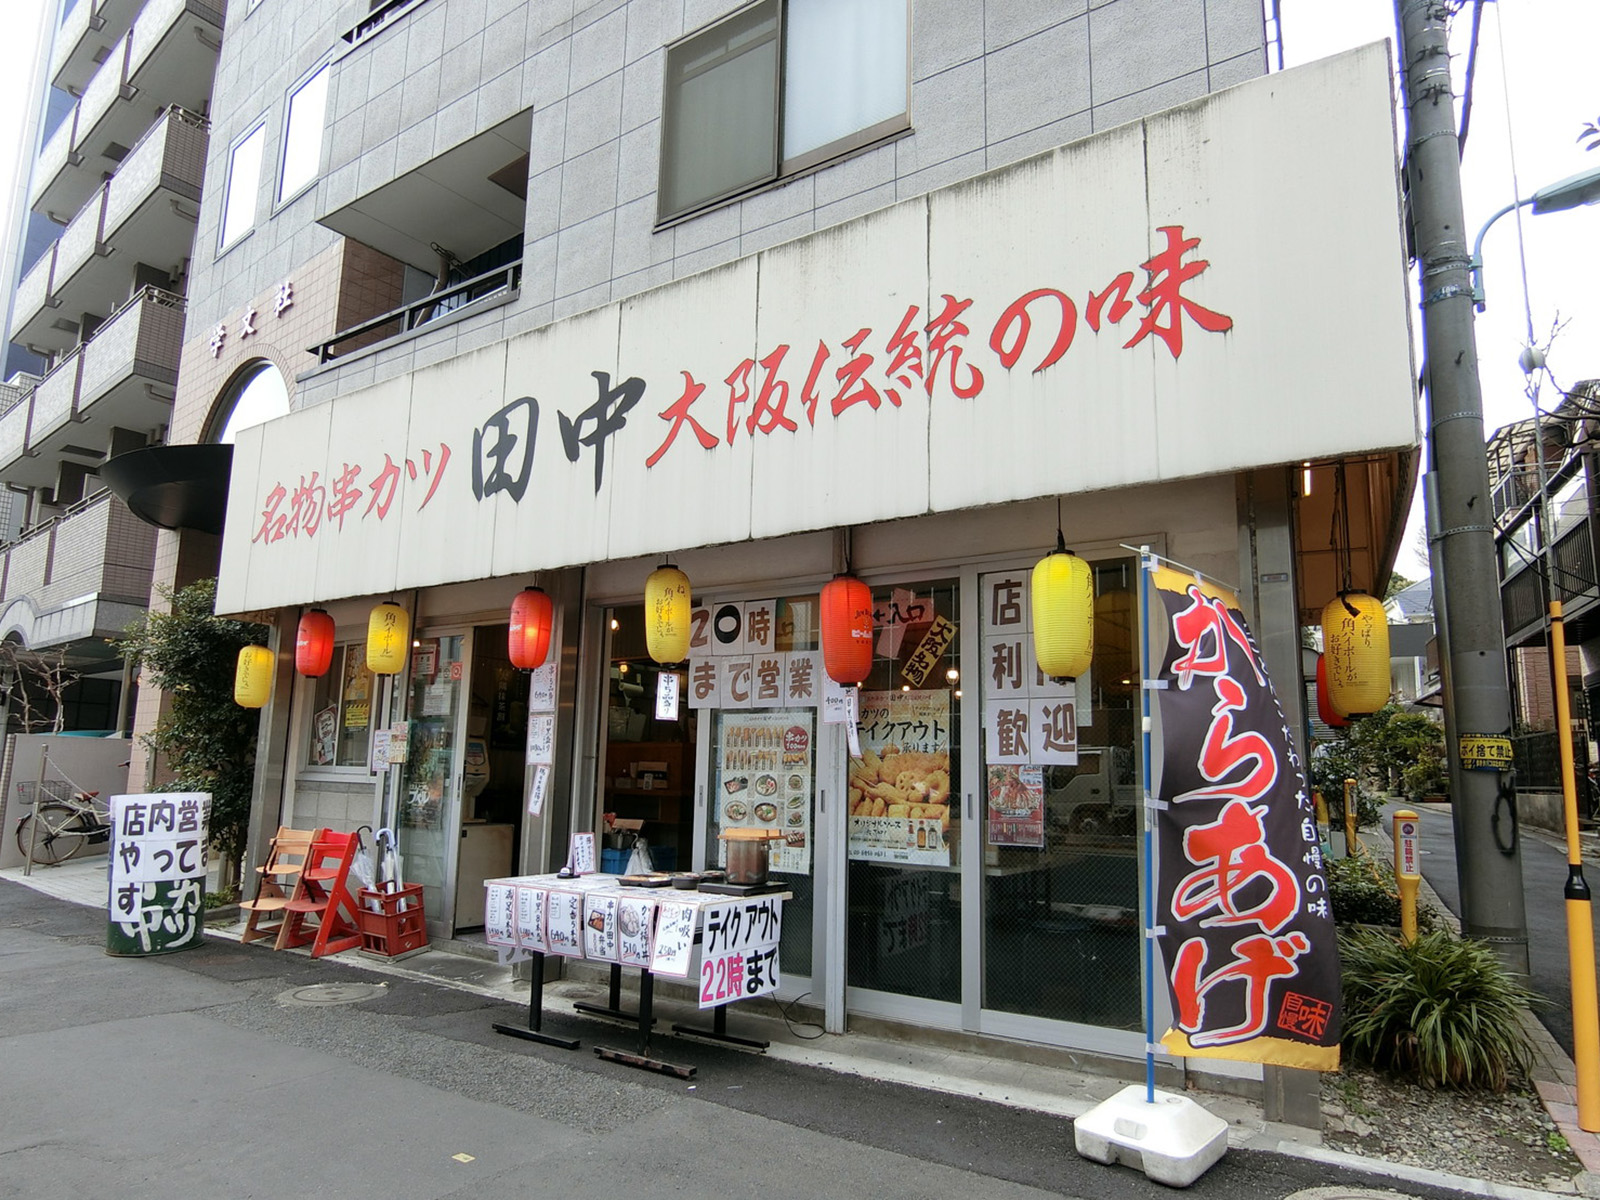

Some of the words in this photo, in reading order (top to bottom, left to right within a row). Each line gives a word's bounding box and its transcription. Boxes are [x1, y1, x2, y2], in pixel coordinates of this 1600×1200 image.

[209, 281, 294, 359] 学文社
[252, 443, 451, 545] 名物串カツ
[471, 371, 646, 502] 田中
[645, 225, 1234, 469] 大阪伝統の味
[383, 611, 396, 656] 角ハイボール
[689, 604, 770, 647] 20時
[886, 602, 925, 624] 入口
[905, 621, 953, 686] 大阪名物
[1341, 617, 1357, 681] 角ハイボールが
[693, 657, 813, 703] まで営業
[997, 702, 1076, 756] 歓迎
[1461, 743, 1512, 758] ポイ捨て禁止
[1172, 584, 1310, 1047] からあげ
[118, 882, 140, 916] す
[166, 879, 201, 948] カツ
[606, 900, 615, 950] 串カツ田中
[598, 934, 606, 956] 弁当
[677, 906, 692, 951] 肉吸い
[708, 898, 778, 953] テイクアウト
[701, 947, 777, 1002] 22時まで
